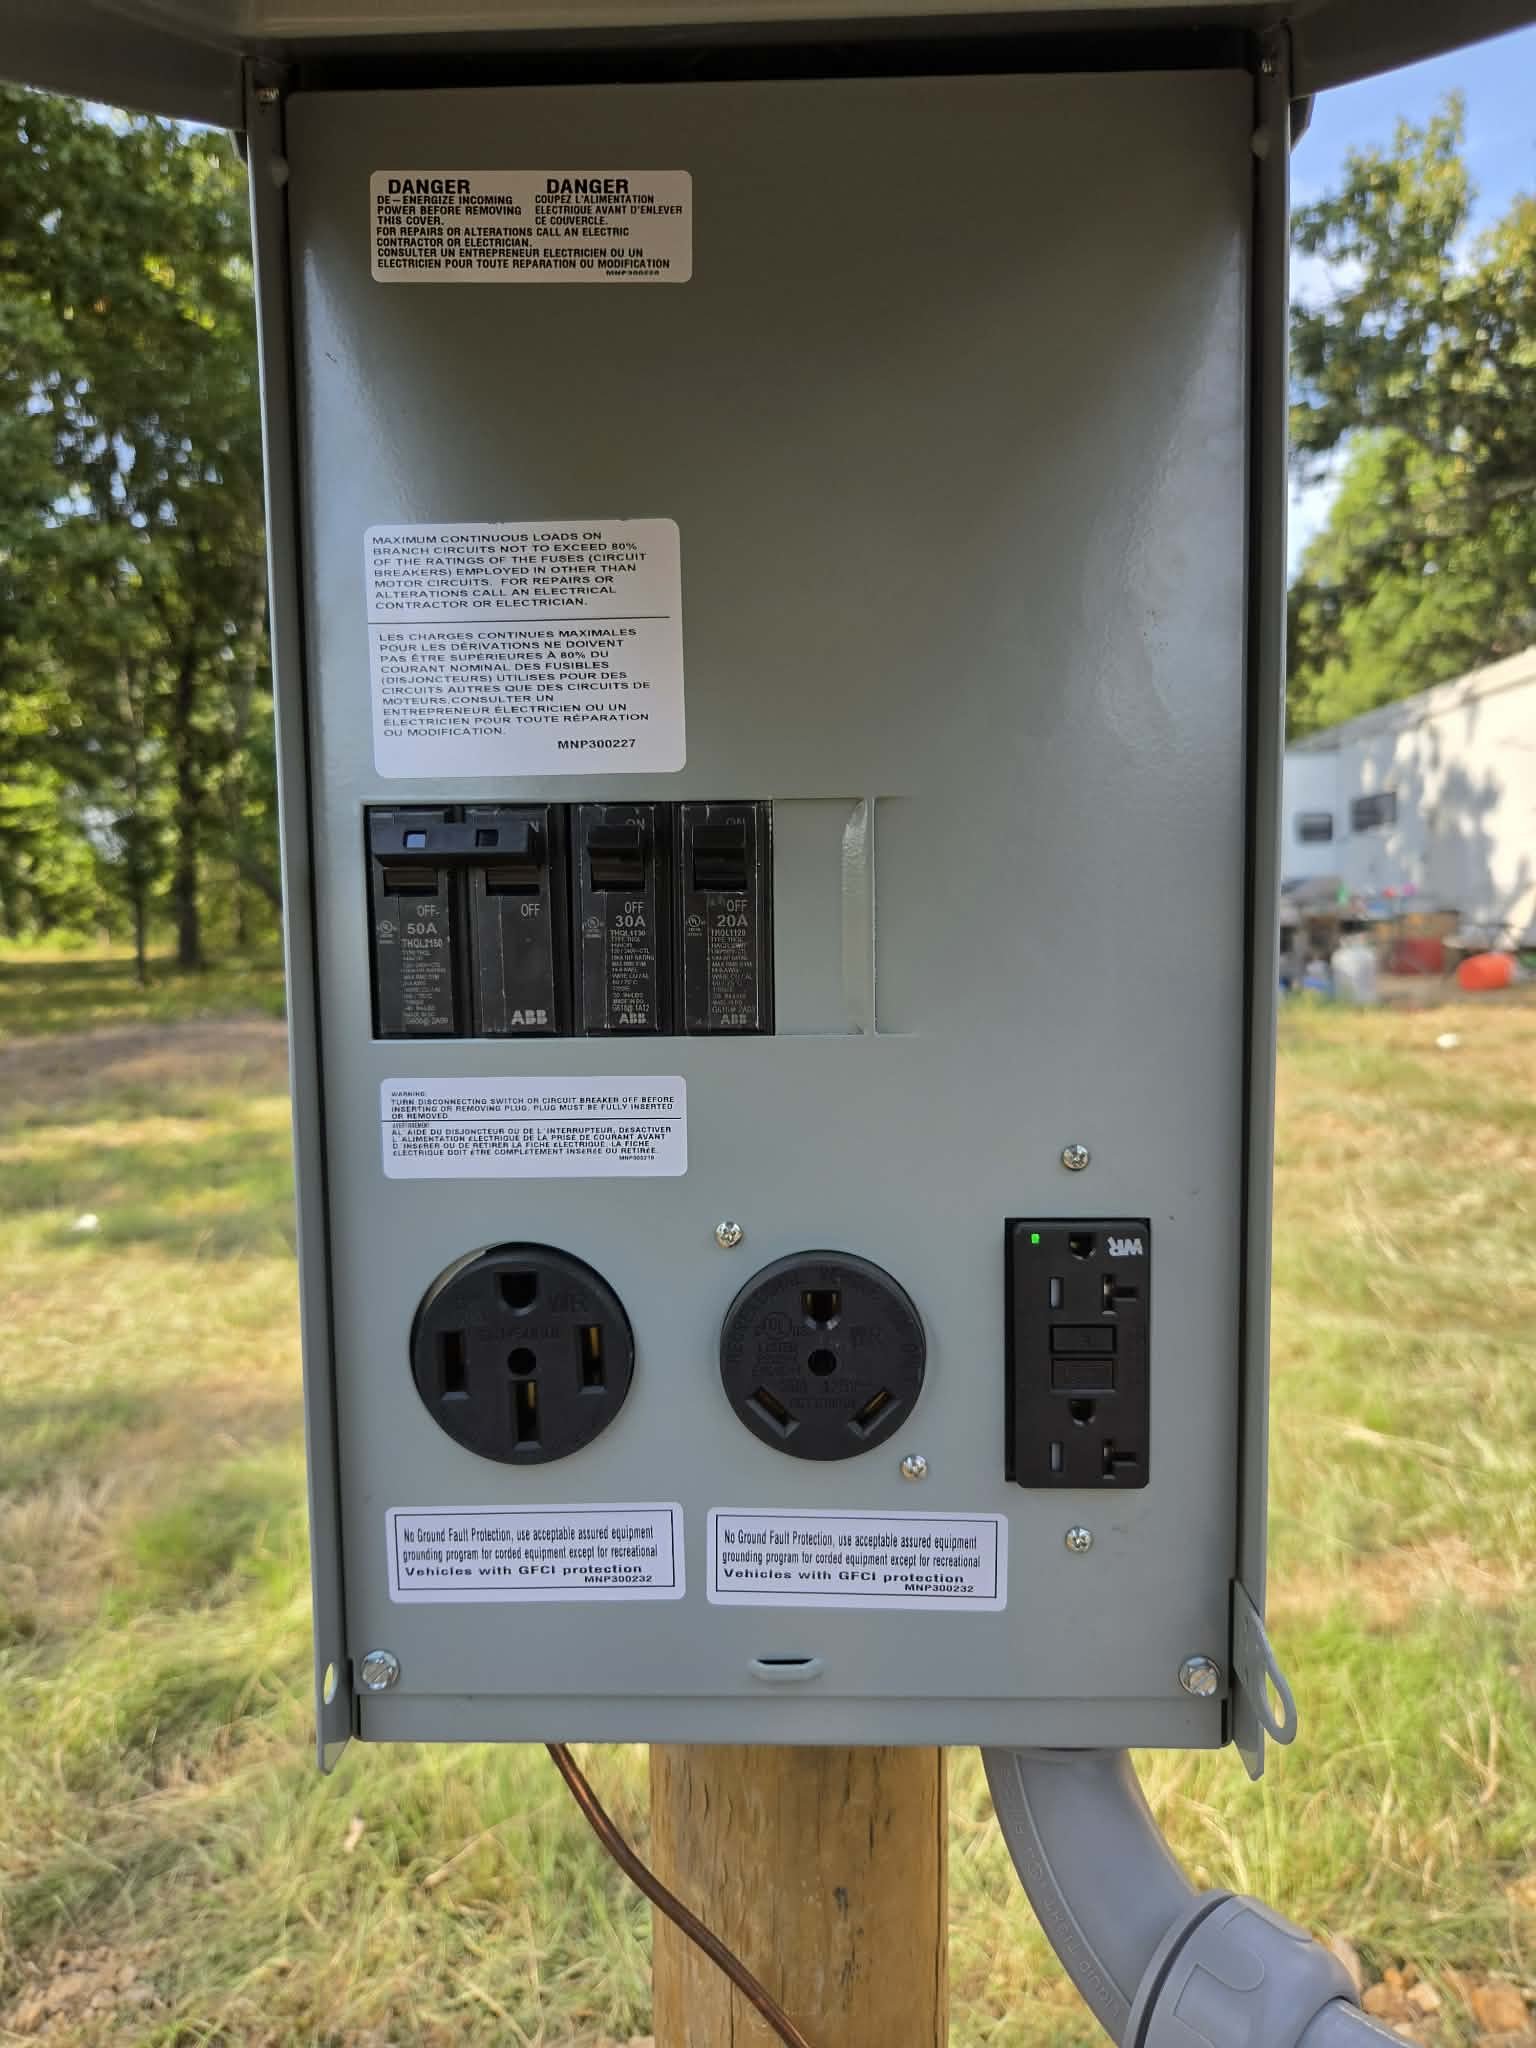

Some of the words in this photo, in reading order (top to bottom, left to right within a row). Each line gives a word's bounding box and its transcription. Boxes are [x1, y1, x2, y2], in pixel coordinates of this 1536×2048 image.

[388, 179, 470, 194] DANGER
[546, 179, 628, 193] DANGER
[459, 196, 512, 204] INCOMING
[534, 195, 571, 203] COUPEZ
[377, 206, 415, 214] POWER
[420, 206, 460, 215] BEFORE
[465, 206, 521, 215] REMOVING
[535, 205, 590, 214] ELECTRIQUE
[595, 205, 626, 214] AVANT
[378, 216, 401, 224] THIS
[535, 216, 546, 225] CE
[376, 227, 396, 235] FOR
[400, 227, 443, 236] REPAIRS
[446, 227, 460, 236] OR
[464, 227, 532, 236] ALTERATIONS
[536, 227, 559, 236] CALL
[564, 227, 578, 236] AN
[582, 227, 629, 236] ELECTRIC
[376, 238, 443, 247] CONTRACTOR
[447, 238, 460, 247] OR
[377, 248, 436, 257] CONSULTER
[440, 248, 455, 257] UN
[459, 248, 539, 257] ENTREPRENEUR
[543, 248, 606, 257] ELECTRICIEN
[610, 248, 624, 257] OU
[628, 248, 643, 257] UN
[377, 259, 441, 268] ELECTRICIEN
[445, 259, 472, 268] POUR
[477, 259, 508, 268] TOUTE
[512, 259, 576, 268] REPARATION
[579, 259, 593, 268] OU
[597, 259, 669, 268] MODIFICATION
[372, 535, 436, 544] MAXIMUM
[440, 534, 528, 543] CONTINUOUS
[533, 532, 577, 541] LOADS
[582, 532, 601, 540] ON
[373, 546, 429, 555] BRANCH
[433, 545, 495, 554] CIRCUITS
[500, 545, 526, 553] NOT
[532, 544, 549, 552] TO
[553, 543, 606, 551] EXCEED
[611, 542, 637, 550] 80%
[373, 558, 388, 566] OF
[396, 557, 419, 565] THE
[425, 556, 484, 565] RATINGS
[488, 556, 504, 564] OF
[511, 555, 536, 563] THE
[541, 554, 584, 563] FUSES
[588, 552, 646, 563] (CIRCUIT
[374, 568, 451, 578] BREAKERS)
[456, 566, 529, 575] EMPLOYED
[533, 566, 545, 574] IN
[550, 565, 595, 573] OTHER
[601, 563, 636, 572] THAN
[374, 579, 422, 588] MOTOR
[501, 577, 527, 585] FOR
[532, 575, 590, 584] REPAIRS
[594, 575, 613, 583] OR
[375, 589, 467, 598] ALTERATIONS
[472, 588, 502, 597] CALL
[511, 588, 529, 596] AN
[534, 585, 616, 595] ELECTRICAL
[375, 600, 467, 610] CONTRACTOR
[379, 633, 403, 641] LES
[409, 632, 473, 641] CHARGES
[477, 630, 554, 639] CONTINUES
[558, 628, 636, 637] MAXIMALES
[557, 738, 635, 749] MNP300227
[416, 904, 437, 917] OFF
[521, 904, 540, 917] OFF
[625, 901, 645, 914] OFF
[727, 899, 748, 912] OFF
[615, 915, 646, 928] 30A
[717, 914, 748, 928] 20A
[407, 922, 438, 935] 50A
[512, 1010, 547, 1025] ABB
[619, 1013, 646, 1025] ABB
[720, 1014, 747, 1025] ABB
[403, 1528, 414, 1542] No
[417, 1527, 445, 1542] Ground
[448, 1527, 468, 1542] Fault
[516, 1529, 530, 1541] use
[533, 1526, 574, 1542] acceptable
[578, 1526, 608, 1540] assured
[611, 1524, 653, 1541] equipment
[724, 1529, 735, 1544] No
[737, 1529, 766, 1545] Ground
[769, 1530, 789, 1545] Fault
[838, 1535, 851, 1546] use
[855, 1532, 897, 1549] acceptable
[900, 1534, 931, 1548] assured
[934, 1534, 976, 1551] equipment
[403, 1547, 442, 1563] grounding
[446, 1549, 478, 1562] program
[481, 1547, 492, 1559] for
[495, 1546, 521, 1559] corded
[524, 1545, 566, 1561] equipment
[569, 1546, 594, 1561] except
[597, 1545, 607, 1558] for
[611, 1543, 657, 1557] recreational
[722, 1550, 762, 1565] grounding
[765, 1552, 798, 1566] program
[801, 1551, 812, 1563] for
[815, 1552, 842, 1564] corded
[845, 1553, 887, 1567] equipment
[890, 1554, 916, 1568] except
[919, 1553, 929, 1566] for
[933, 1554, 980, 1568] recreational
[405, 1566, 472, 1576] Vehicles
[479, 1565, 511, 1575] with
[518, 1565, 555, 1574] GFCI
[563, 1564, 641, 1576] protection
[724, 1568, 791, 1579] Vehicles
[798, 1570, 831, 1580] with
[838, 1571, 875, 1581] GFCI
[883, 1573, 963, 1584] protection
[584, 1575, 652, 1583] MNP300232
[904, 1583, 973, 1592] MNP300232
